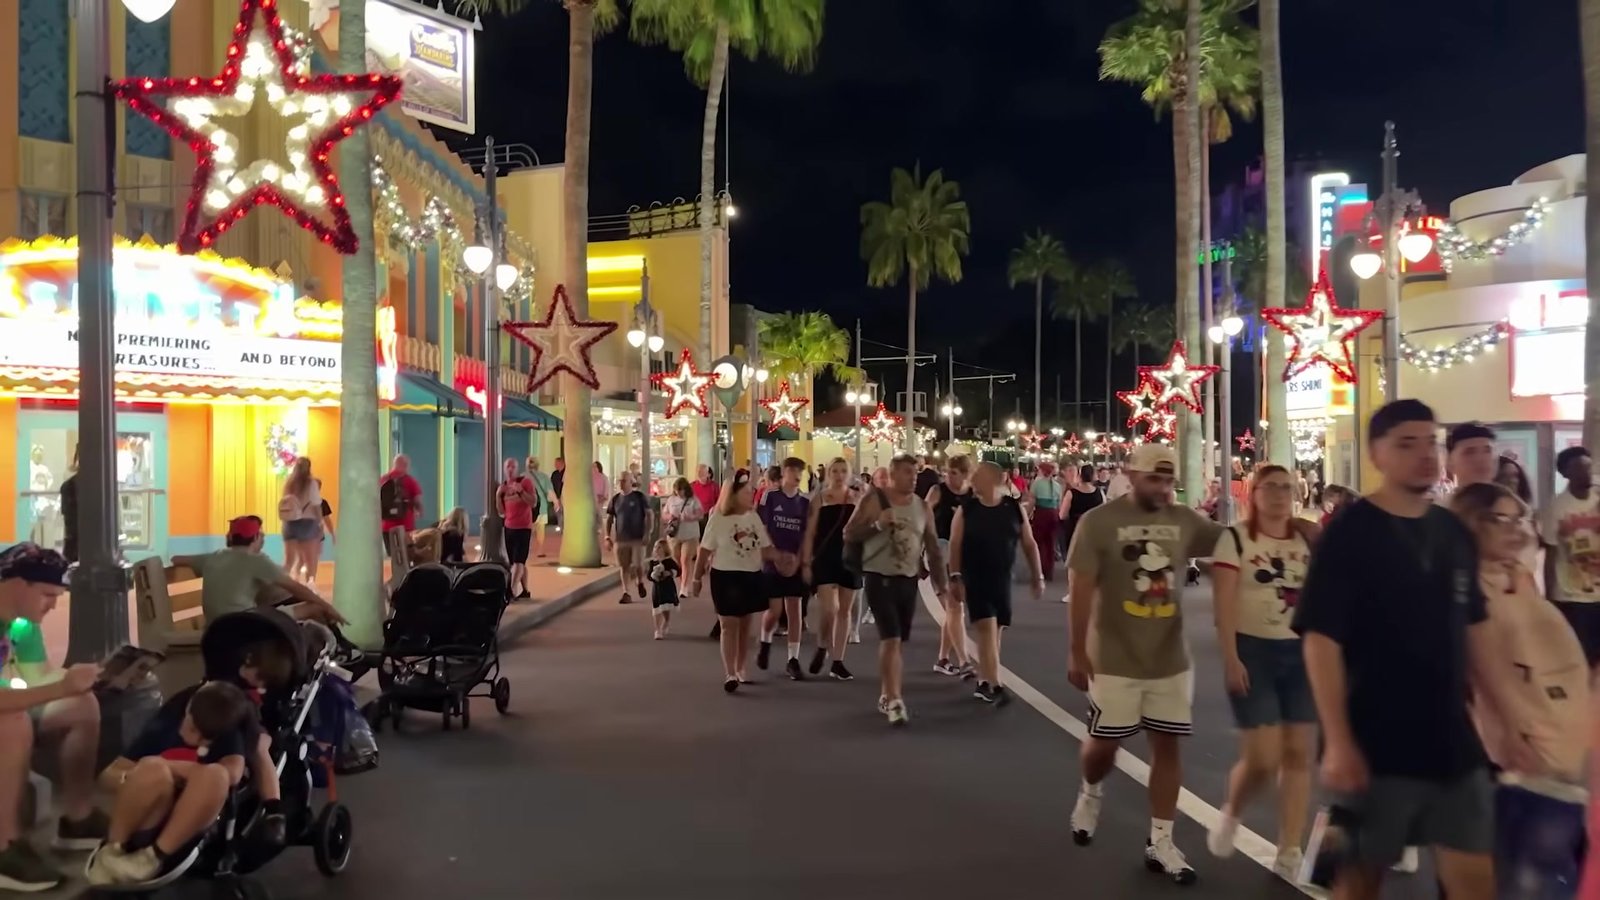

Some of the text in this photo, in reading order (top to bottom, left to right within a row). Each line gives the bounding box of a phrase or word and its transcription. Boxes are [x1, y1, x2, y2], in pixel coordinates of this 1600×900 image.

[117, 333, 211, 350] PREMIERING
[114, 352, 216, 371] REASURES...
[240, 352, 337, 368] AND BEYOND
